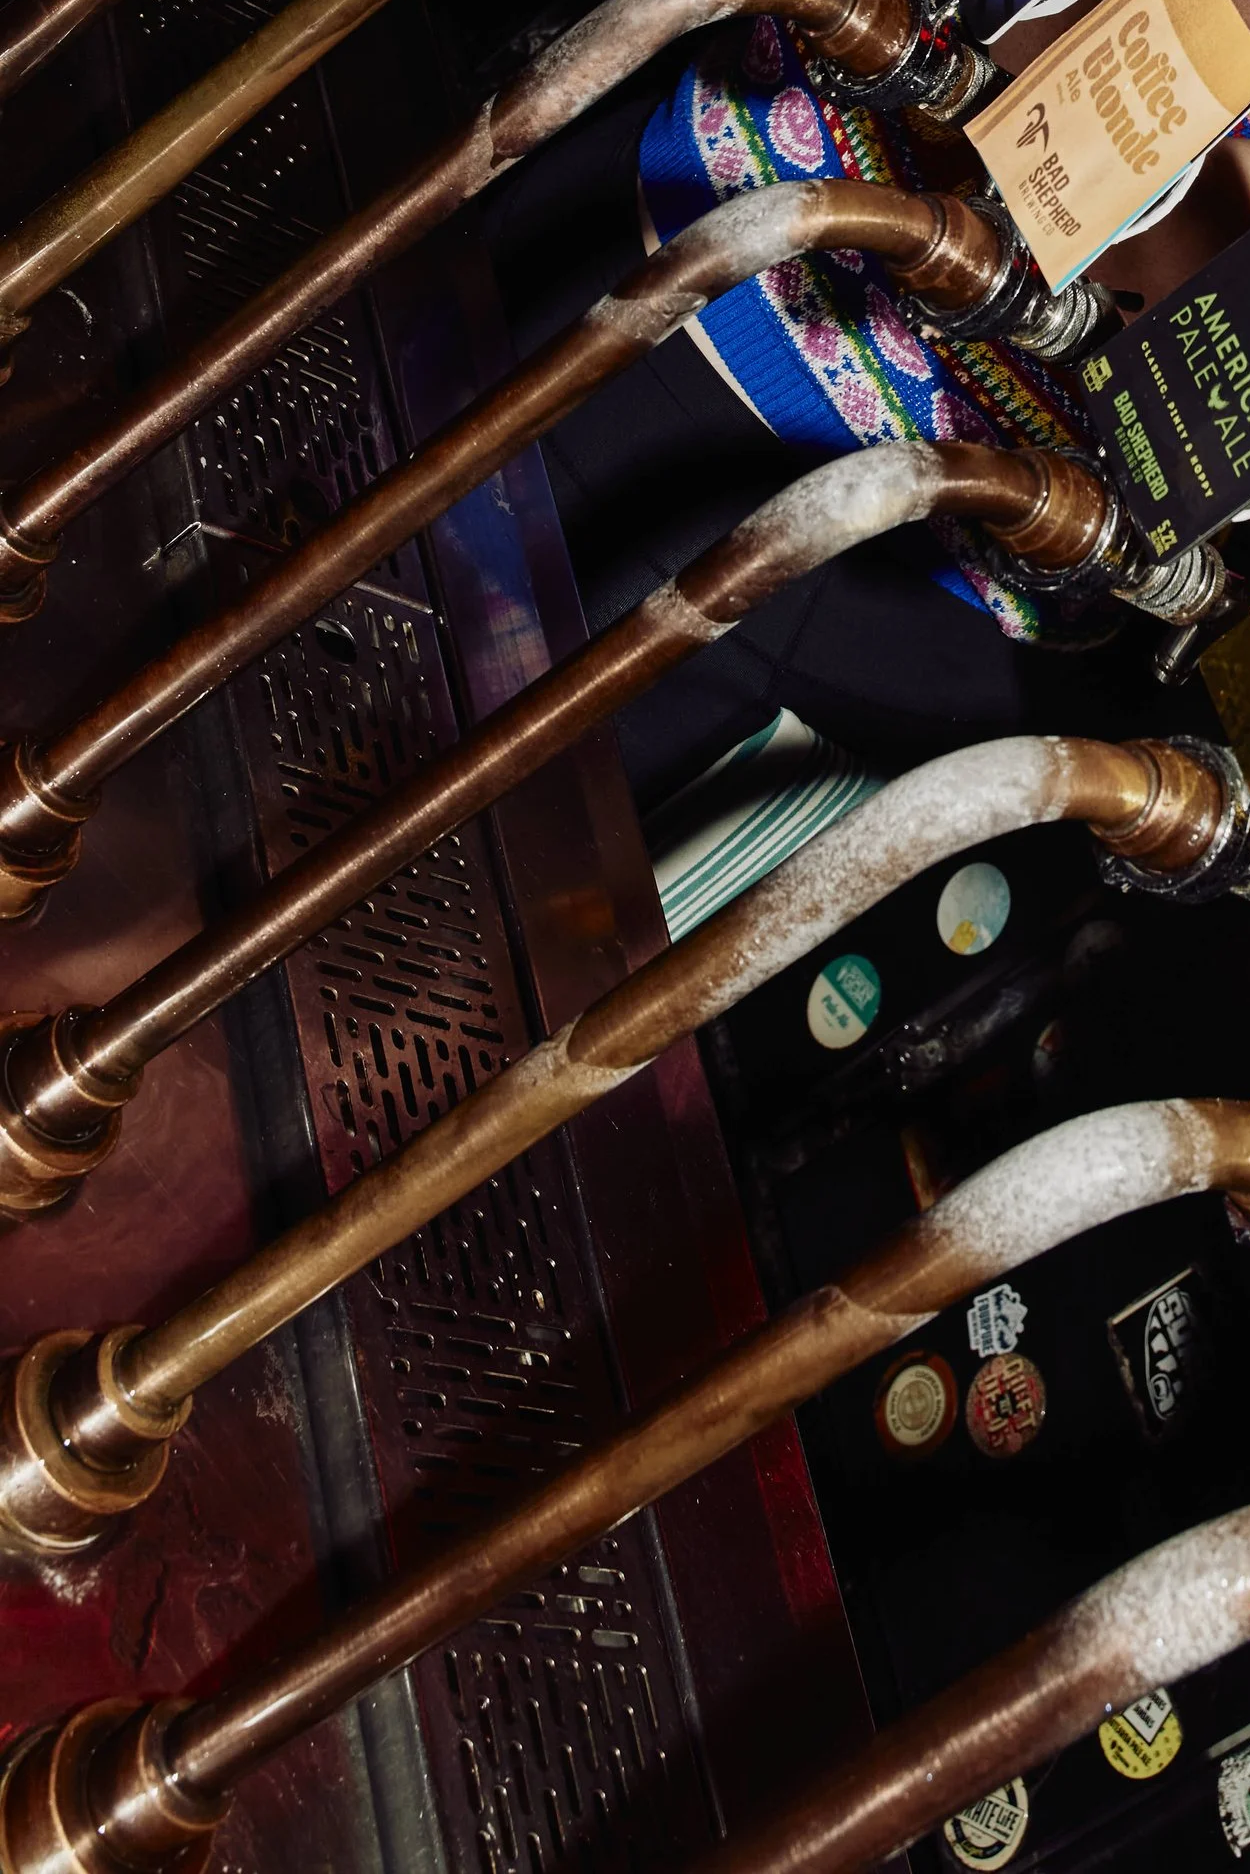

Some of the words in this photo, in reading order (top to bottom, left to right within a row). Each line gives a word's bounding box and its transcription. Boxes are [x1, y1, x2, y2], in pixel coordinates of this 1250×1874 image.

[1065, 69, 1081, 103] Ale
[1082, 36, 1161, 174] Blonde
[1118, 10, 1188, 135] Coffee
[1028, 167, 1082, 238] SHEPHERD
[1043, 152, 1070, 192] BAD
[1018, 182, 1048, 224] BREWING
[1041, 222, 1056, 236] CO
[1169, 305, 1219, 390] PALE
[1114, 390, 1133, 425] BAD
[1125, 424, 1170, 502] SHEPHERD
[1141, 340, 1169, 399] CLASSIC,
[1167, 401, 1189, 440] PINEY
[1189, 456, 1213, 498] HOPPY
[1114, 425, 1137, 471] BREWING
[1131, 468, 1143, 485] CO
[968, 1294, 1001, 1358] FOURPURE
